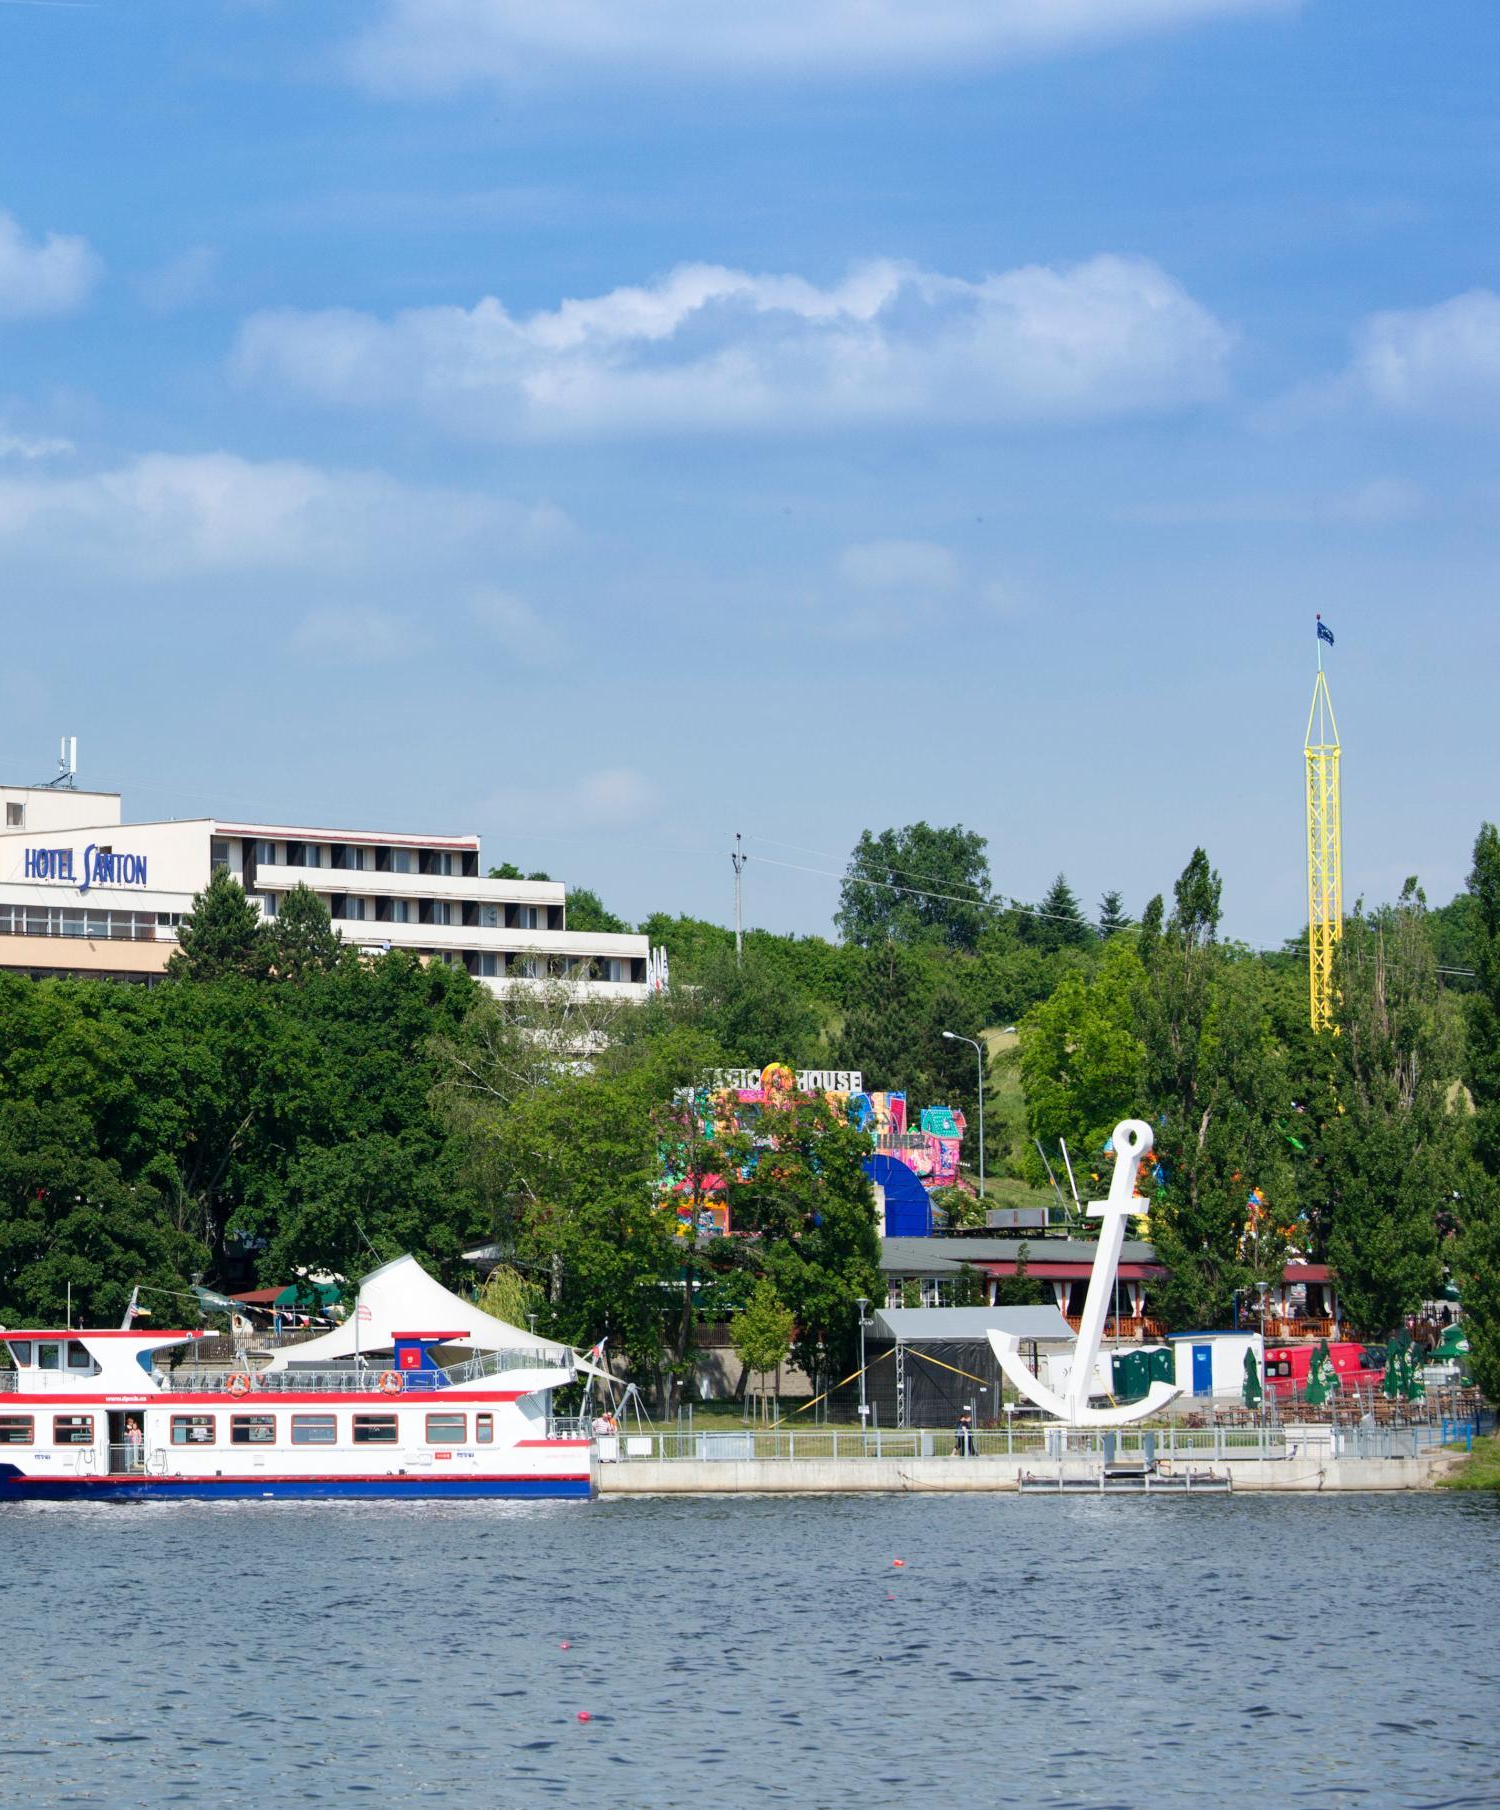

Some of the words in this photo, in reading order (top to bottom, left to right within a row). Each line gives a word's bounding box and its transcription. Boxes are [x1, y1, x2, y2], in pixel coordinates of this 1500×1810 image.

[25, 848, 77, 880] HOTEL
[79, 843, 147, 892] SANTON
[797, 1070, 863, 1091] HOUSE
